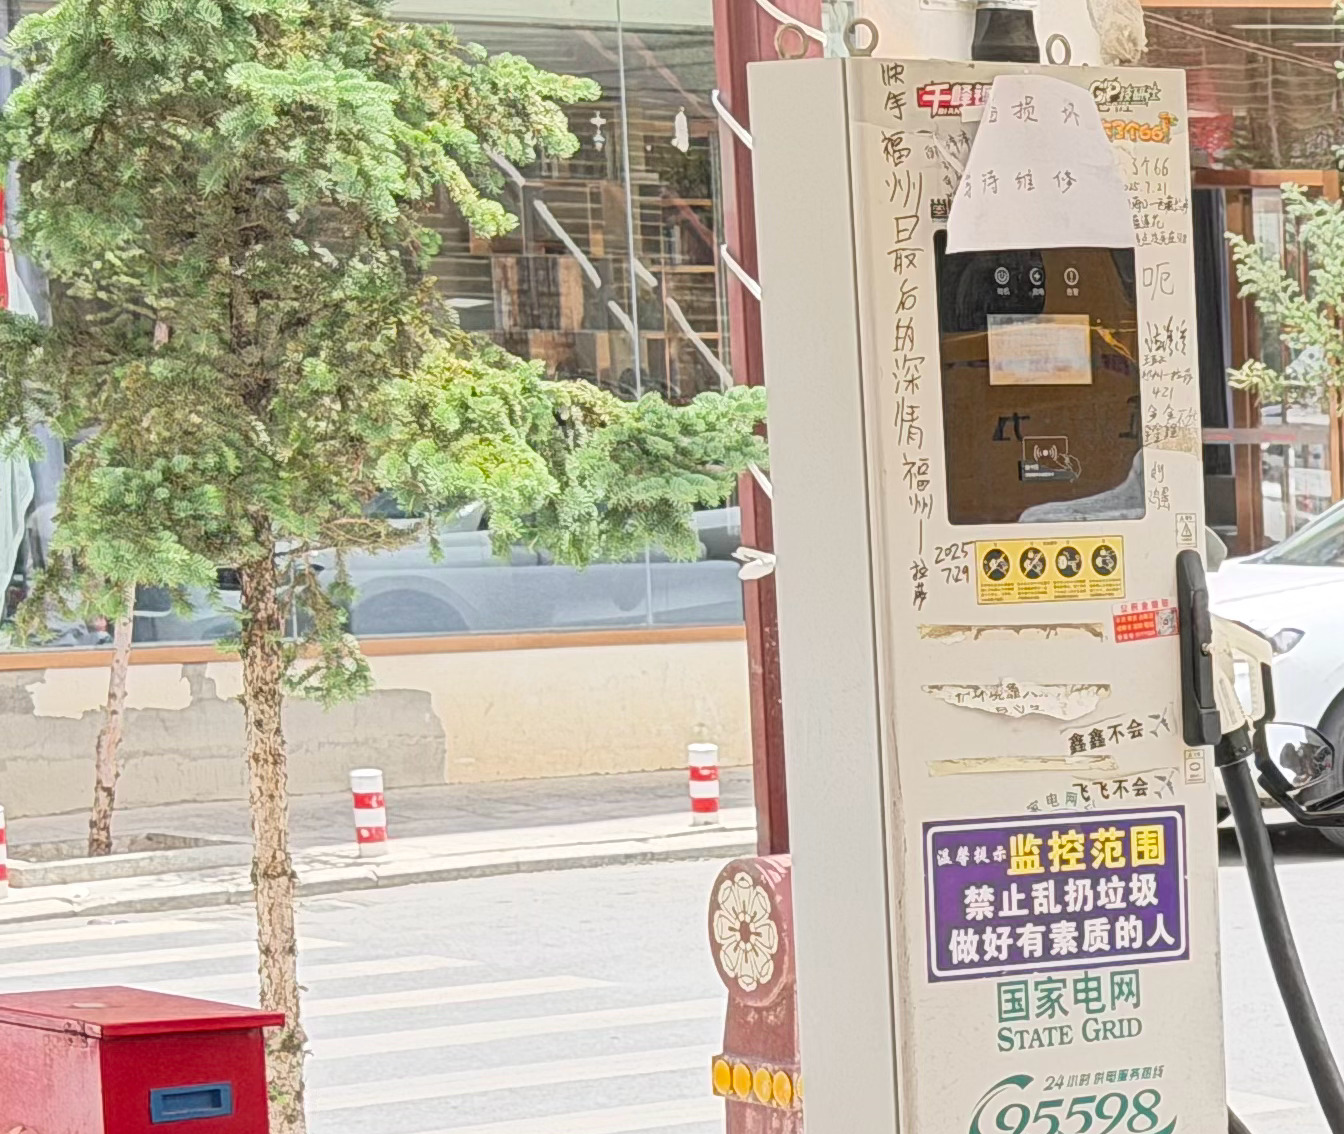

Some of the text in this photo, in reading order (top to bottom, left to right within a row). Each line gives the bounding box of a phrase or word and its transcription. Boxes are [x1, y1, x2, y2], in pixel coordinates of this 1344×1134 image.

[1068, 718, 1144, 756] 鑫鑫不会
[1072, 776, 1149, 801] 飞飞不会
[1007, 823, 1166, 876] 监控范围
[963, 872, 1159, 921] 禁止乱扔垃圾
[948, 912, 1176, 965] 做好有素质的人
[996, 968, 1141, 1023] 国家电网
[997, 1016, 1143, 1052] STATE GRID
